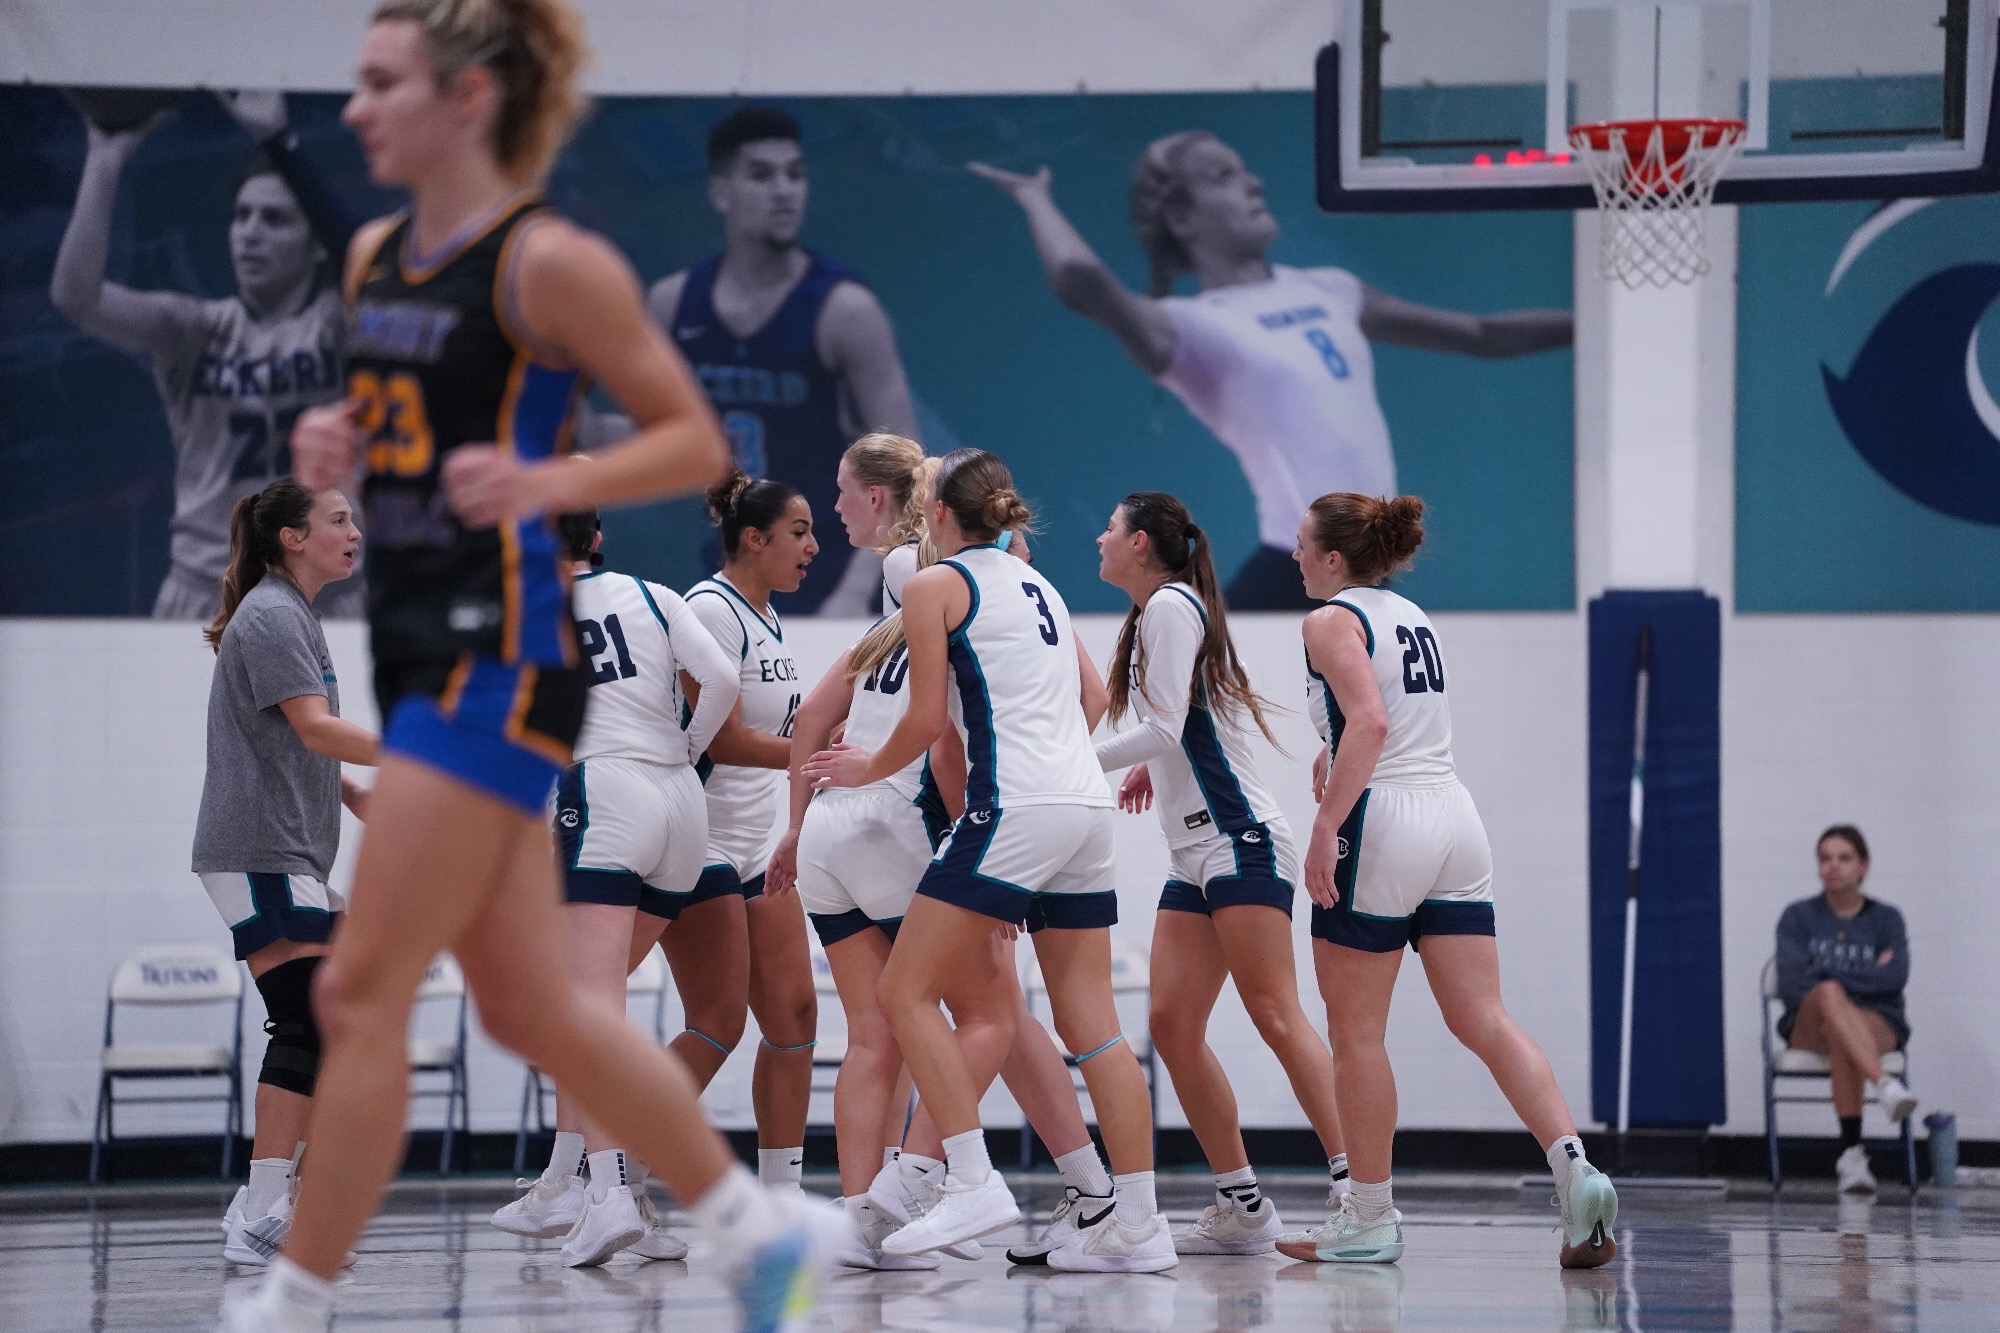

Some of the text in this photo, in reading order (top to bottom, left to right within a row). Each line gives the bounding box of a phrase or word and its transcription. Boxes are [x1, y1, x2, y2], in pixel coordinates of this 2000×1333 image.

[1304, 329, 1350, 381] 8
[348, 367, 434, 477] 23
[1022, 581, 1059, 646] 3
[576, 613, 637, 688] 21
[760, 657, 798, 683] ECKE
[1396, 625, 1445, 694] 20
